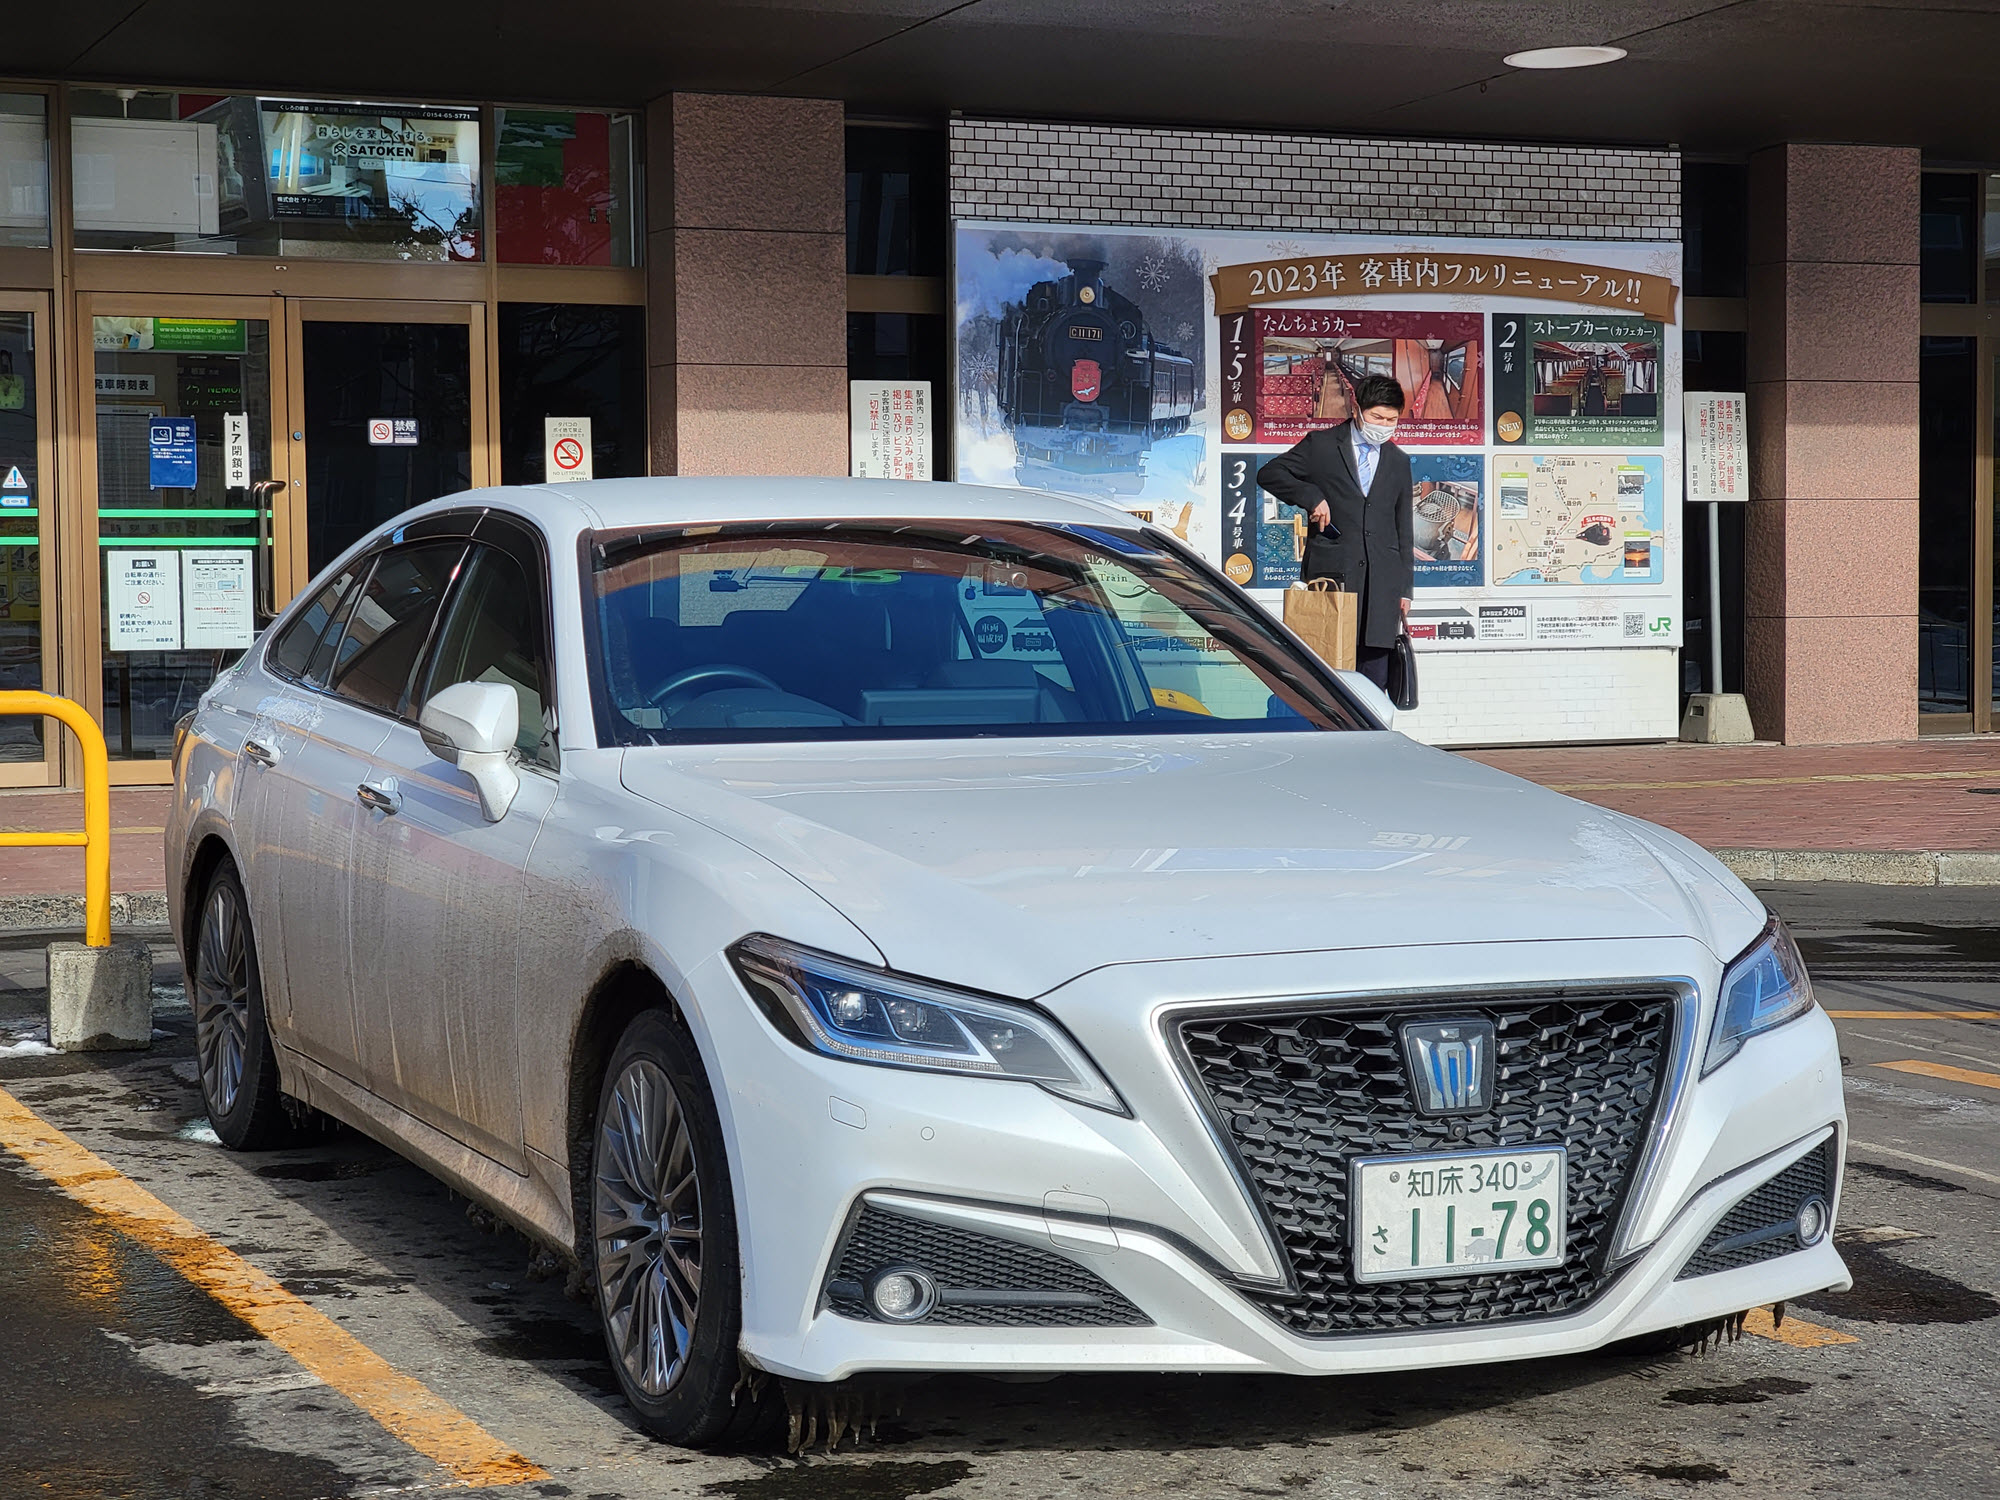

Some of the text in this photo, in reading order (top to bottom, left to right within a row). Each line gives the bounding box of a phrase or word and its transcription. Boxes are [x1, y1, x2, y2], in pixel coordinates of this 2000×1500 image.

[317, 127, 434, 143] 暮らしを楽しくする。
[349, 144, 414, 157] SATOKEN
[1249, 259, 1347, 297] 2023年
[1262, 314, 1362, 333] たんちょうカー
[1532, 319, 1609, 336] ストーブカー
[394, 420, 417, 432] 禁煙
[869, 392, 879, 461] 一切禁止します。
[1500, 421, 1521, 432] NEW
[1700, 402, 1708, 464] 一切禁止します。
[231, 420, 243, 481] ドア閉鎖中
[1099, 573, 1128, 582] Train
[1227, 563, 1251, 577] NEW
[1649, 617, 1672, 632] JR
[1407, 1161, 1518, 1198] 知床 340
[1372, 1198, 1551, 1267] さ 11-78
